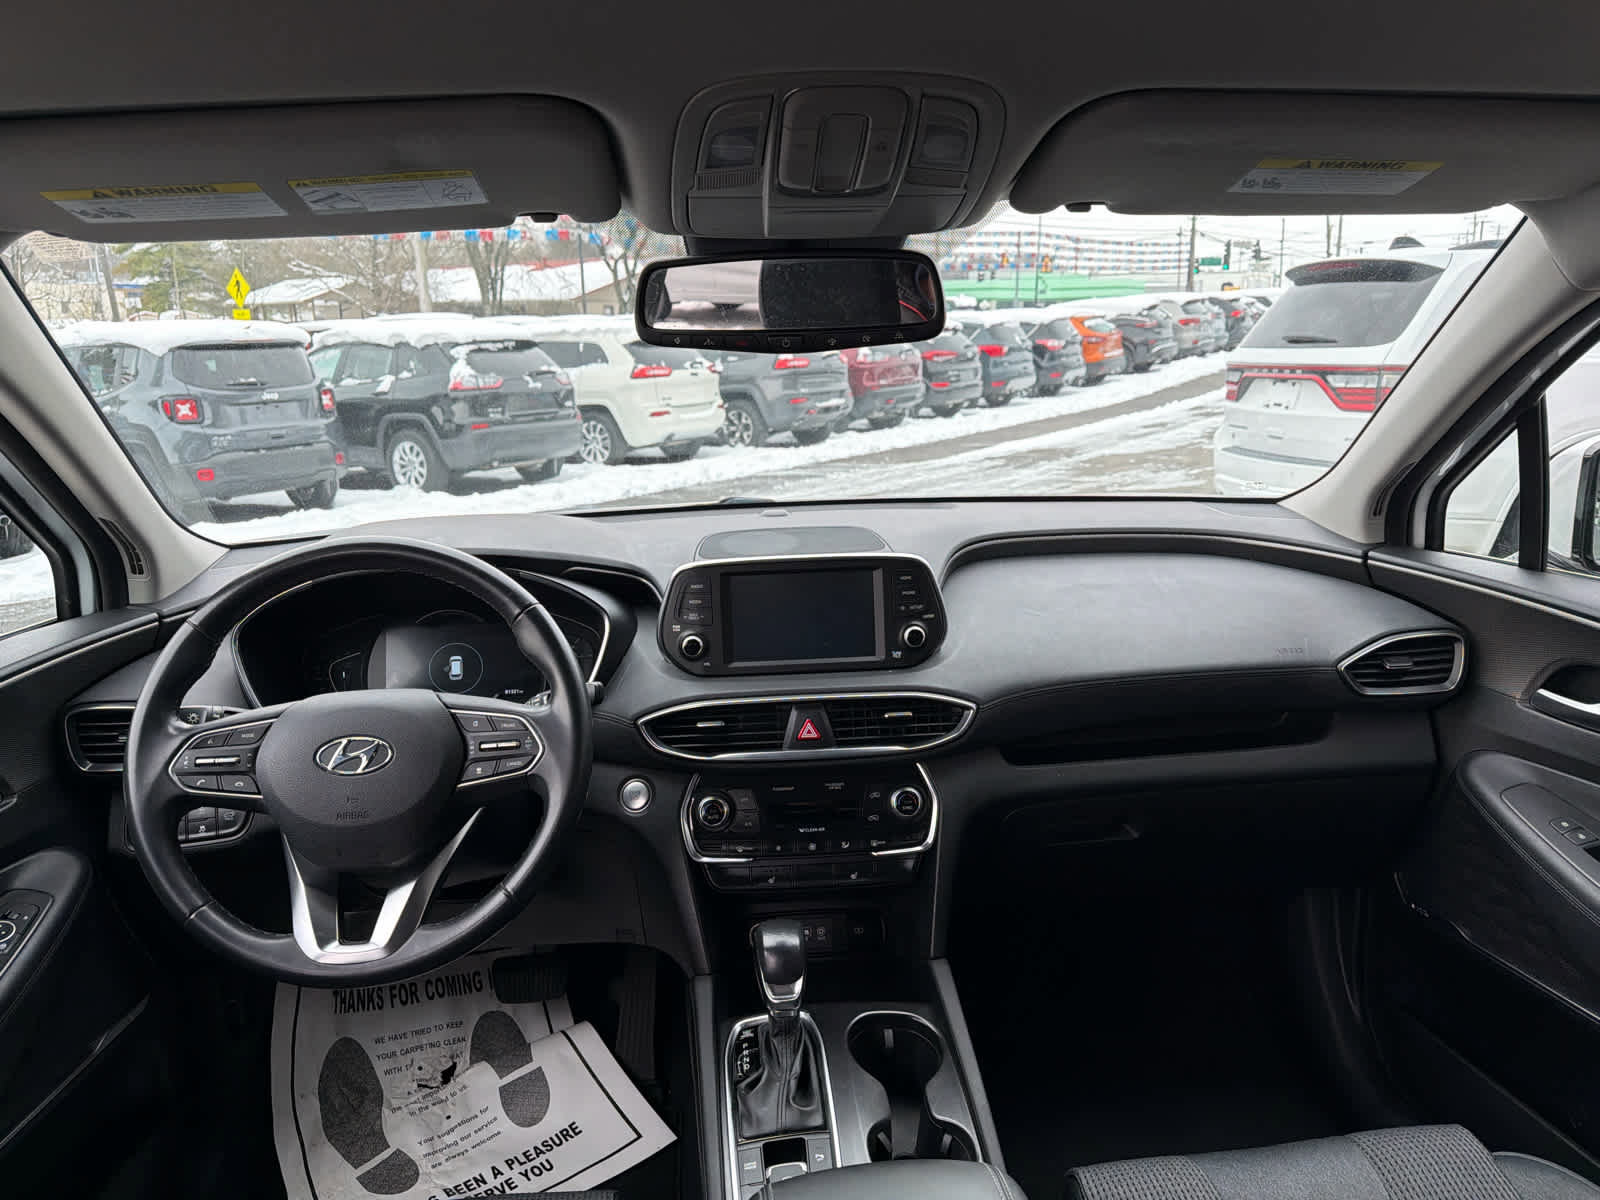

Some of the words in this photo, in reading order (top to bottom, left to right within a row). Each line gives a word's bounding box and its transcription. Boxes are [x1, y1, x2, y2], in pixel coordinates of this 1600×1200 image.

[1319, 160, 1407, 170] WARNING
[115, 184, 220, 198] WARNING
[332, 986, 385, 1014] THANKS
[388, 981, 420, 1008] FOR
[424, 970, 483, 1001] COMING
[374, 1036, 386, 1046] WE
[388, 1031, 408, 1042] HAVE
[409, 1027, 432, 1038] TRIED
[434, 1023, 444, 1032] TO
[446, 1020, 464, 1030] KEEP
[375, 1050, 398, 1061] YOUR
[399, 1040, 442, 1057] CARPETING
[443, 1036, 467, 1047] CLEAN
[383, 1066, 403, 1077] WITH
[442, 1172, 488, 1198] BEEN
[490, 1165, 505, 1180] A
[503, 1121, 583, 1171] PLEASURE
[518, 1158, 555, 1183] YOU
